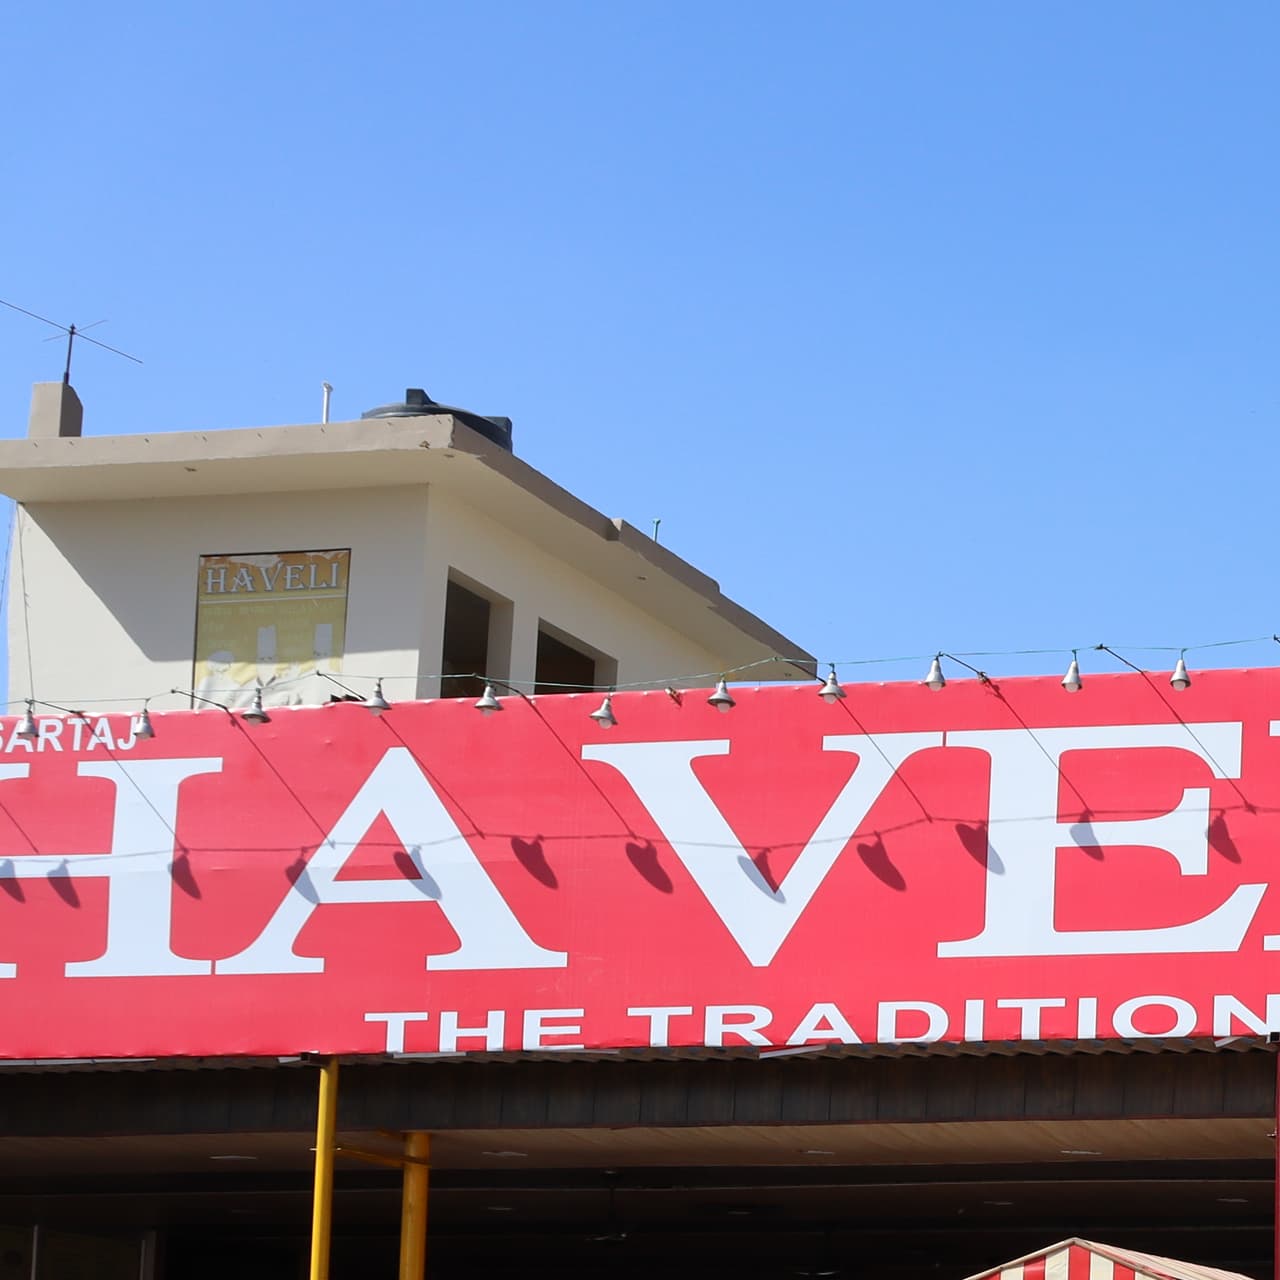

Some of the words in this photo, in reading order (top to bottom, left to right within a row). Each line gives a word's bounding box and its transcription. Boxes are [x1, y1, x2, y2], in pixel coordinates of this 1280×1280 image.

[205, 562, 339, 594] HAVELI
[0, 716, 138, 752] ARTAJ
[364, 1008, 585, 1054] THE
